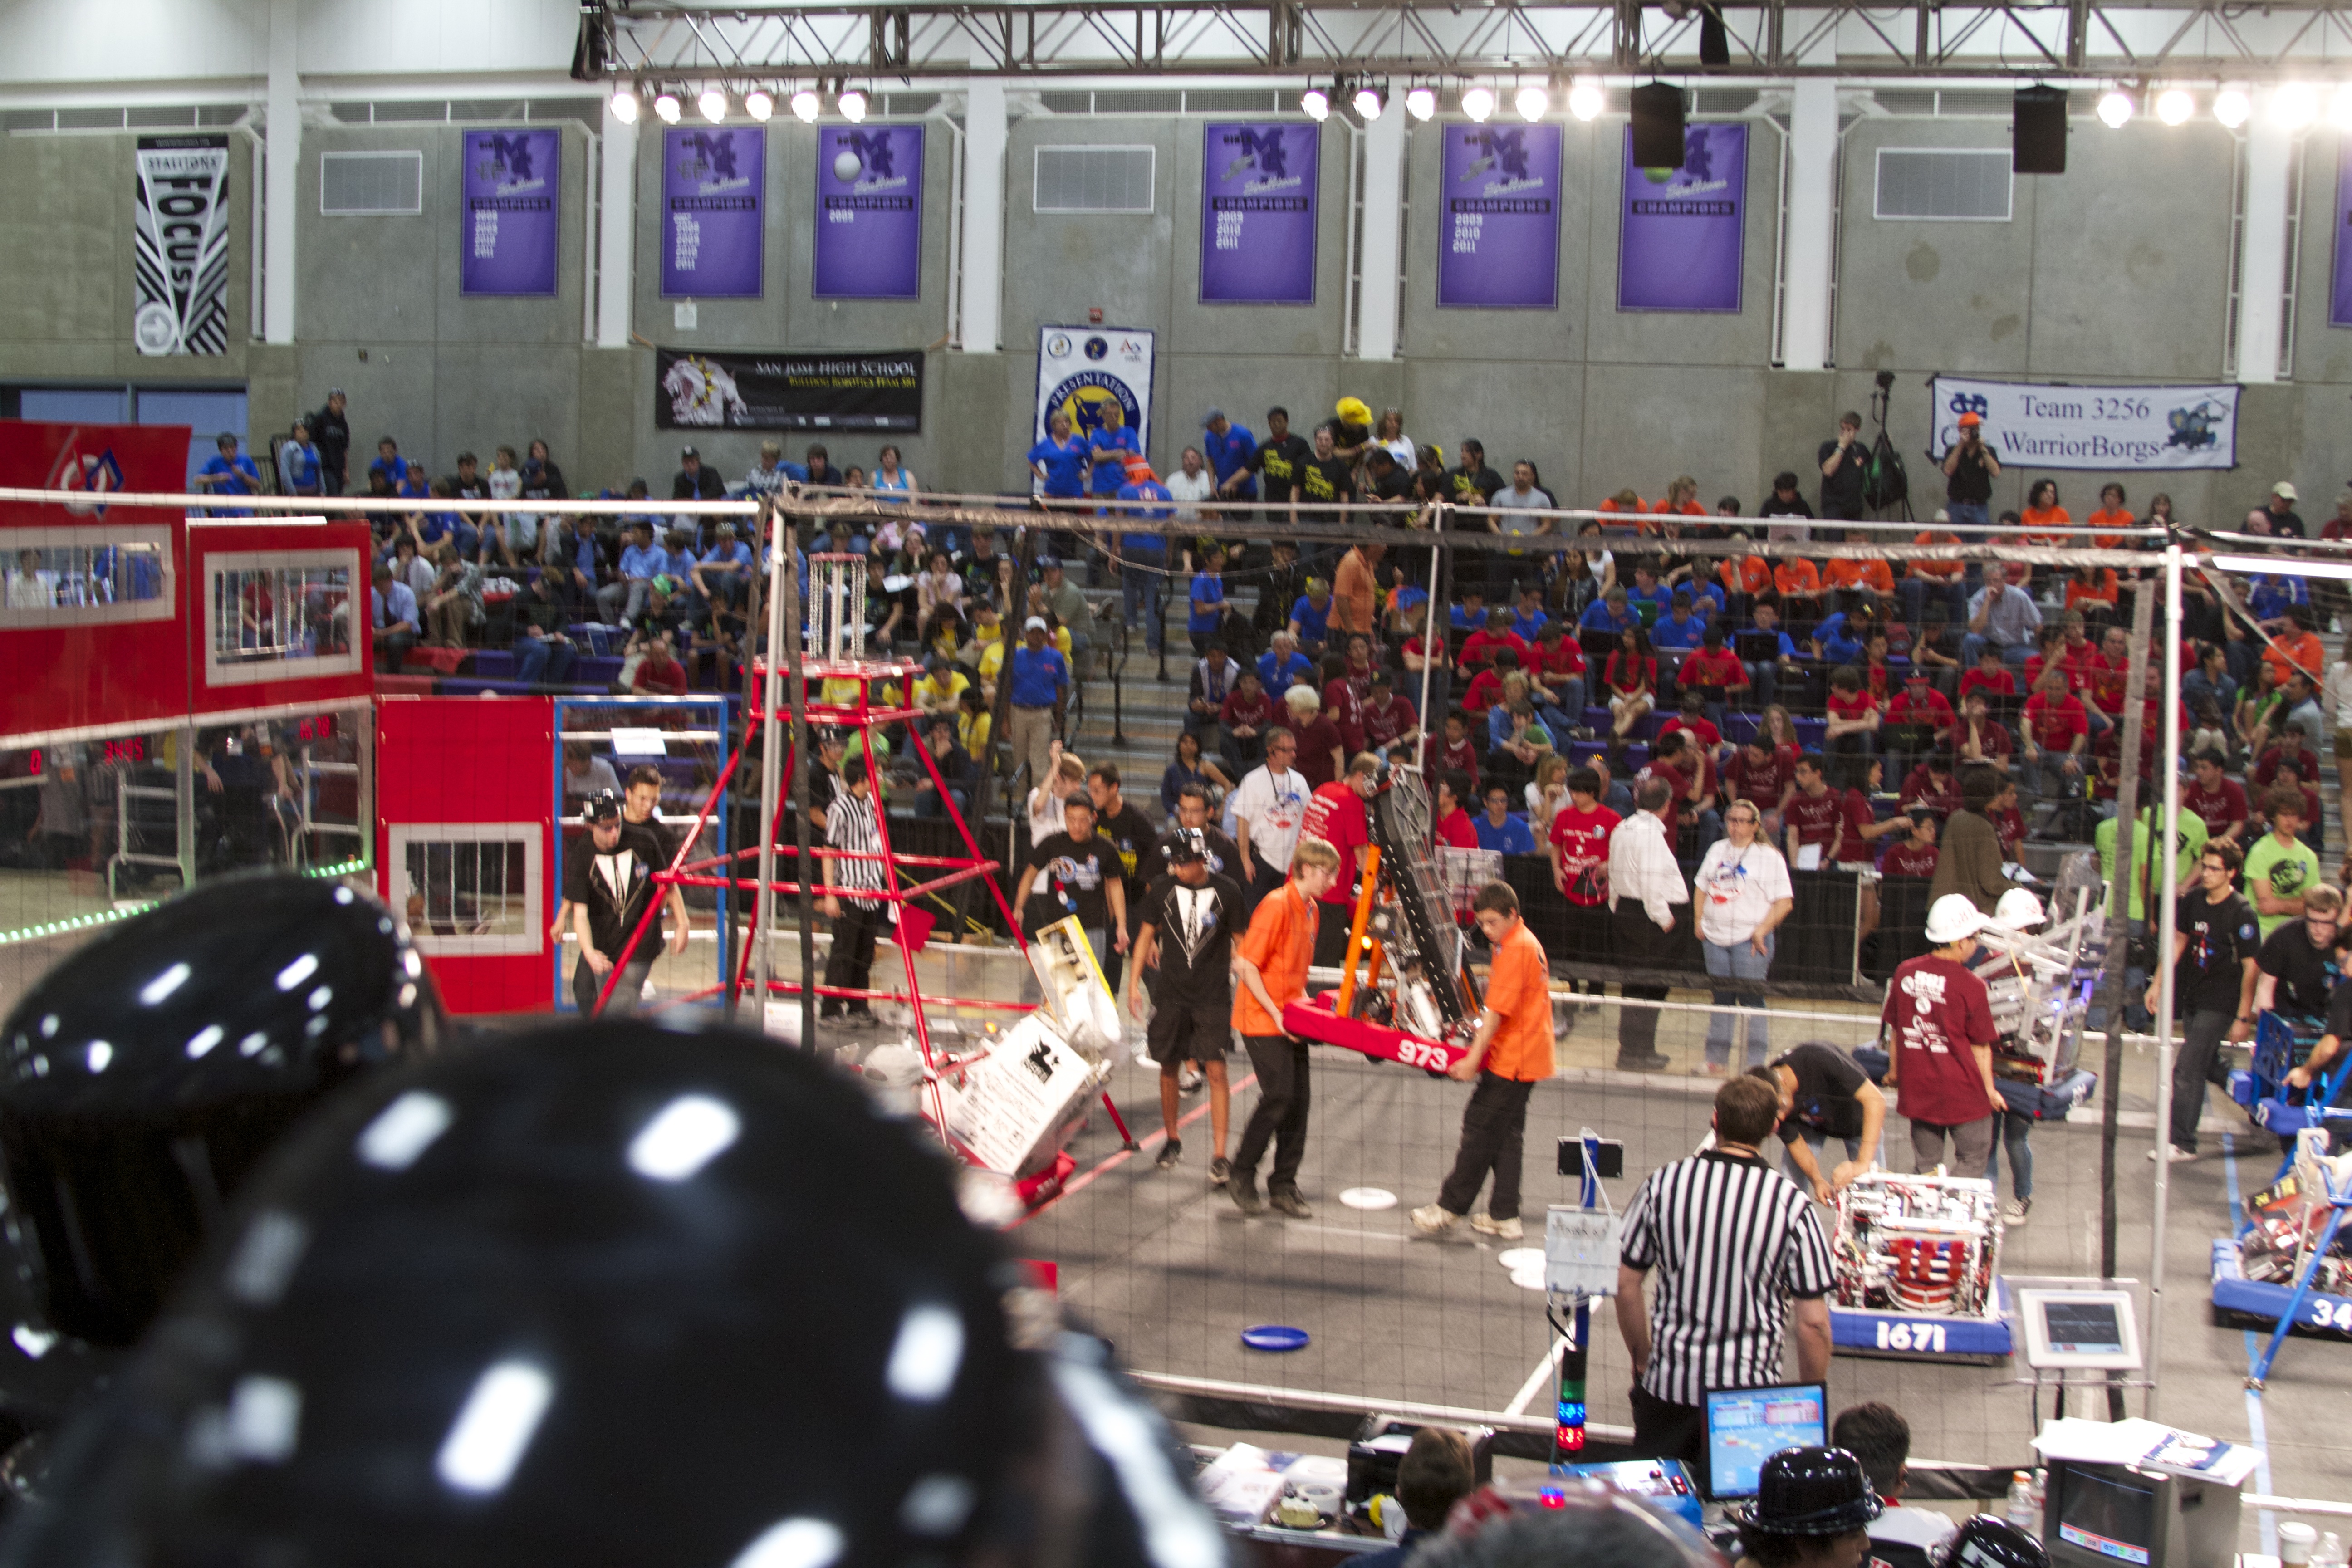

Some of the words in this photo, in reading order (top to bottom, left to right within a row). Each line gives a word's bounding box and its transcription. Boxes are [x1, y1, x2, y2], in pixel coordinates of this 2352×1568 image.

[149, 157, 216, 170] STALLIONS
[1216, 198, 1305, 210] CHAMPIONS
[1455, 200, 1546, 212] CHAMPIONS
[1636, 201, 1730, 214] CHAMPIONS
[1217, 211, 1244, 224] 2009
[1455, 213, 1483, 226] 2009
[153, 176, 211, 292] FOCUS
[1217, 224, 1240, 236] 2010
[1454, 226, 1480, 240] 2010
[1216, 235, 1238, 249] 2011
[1453, 239, 1476, 253] 2011
[756, 360, 781, 376] SAN
[785, 362, 815, 376] JOSE
[819, 361, 857, 376] HIGH
[861, 360, 917, 376] SCHOOL
[2019, 394, 2083, 420] Team
[2091, 396, 2150, 421] 3256
[2001, 431, 2160, 463] WarriorBorgs
[1397, 1039, 1449, 1071] 973
[2311, 1298, 2352, 1331] 34
[1877, 1321, 1946, 1352] 1671
